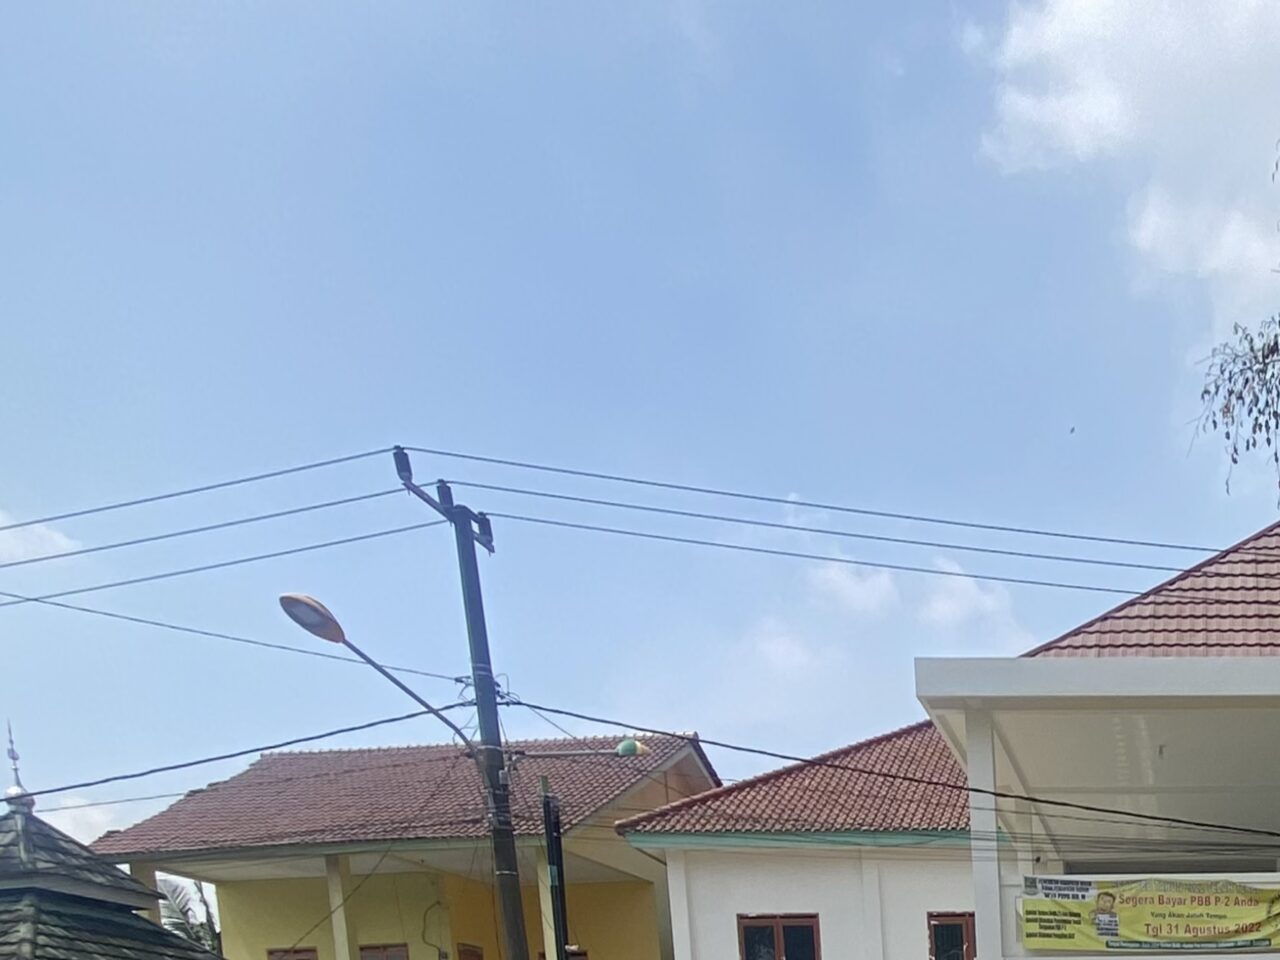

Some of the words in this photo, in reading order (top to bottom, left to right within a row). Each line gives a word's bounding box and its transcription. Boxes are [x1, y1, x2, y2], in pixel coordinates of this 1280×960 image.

[1119, 894, 1154, 907] Segera
[1158, 895, 1187, 907] Bayar
[1190, 895, 1211, 906] PBB
[1214, 896, 1230, 906] P-2
[1233, 896, 1260, 907] Anda
[1150, 911, 1166, 919] Yang
[1144, 923, 1162, 937] Tgl
[1167, 923, 1179, 934] 31
[1184, 924, 1231, 937] Agustus
[1234, 922, 1262, 934] 2022
